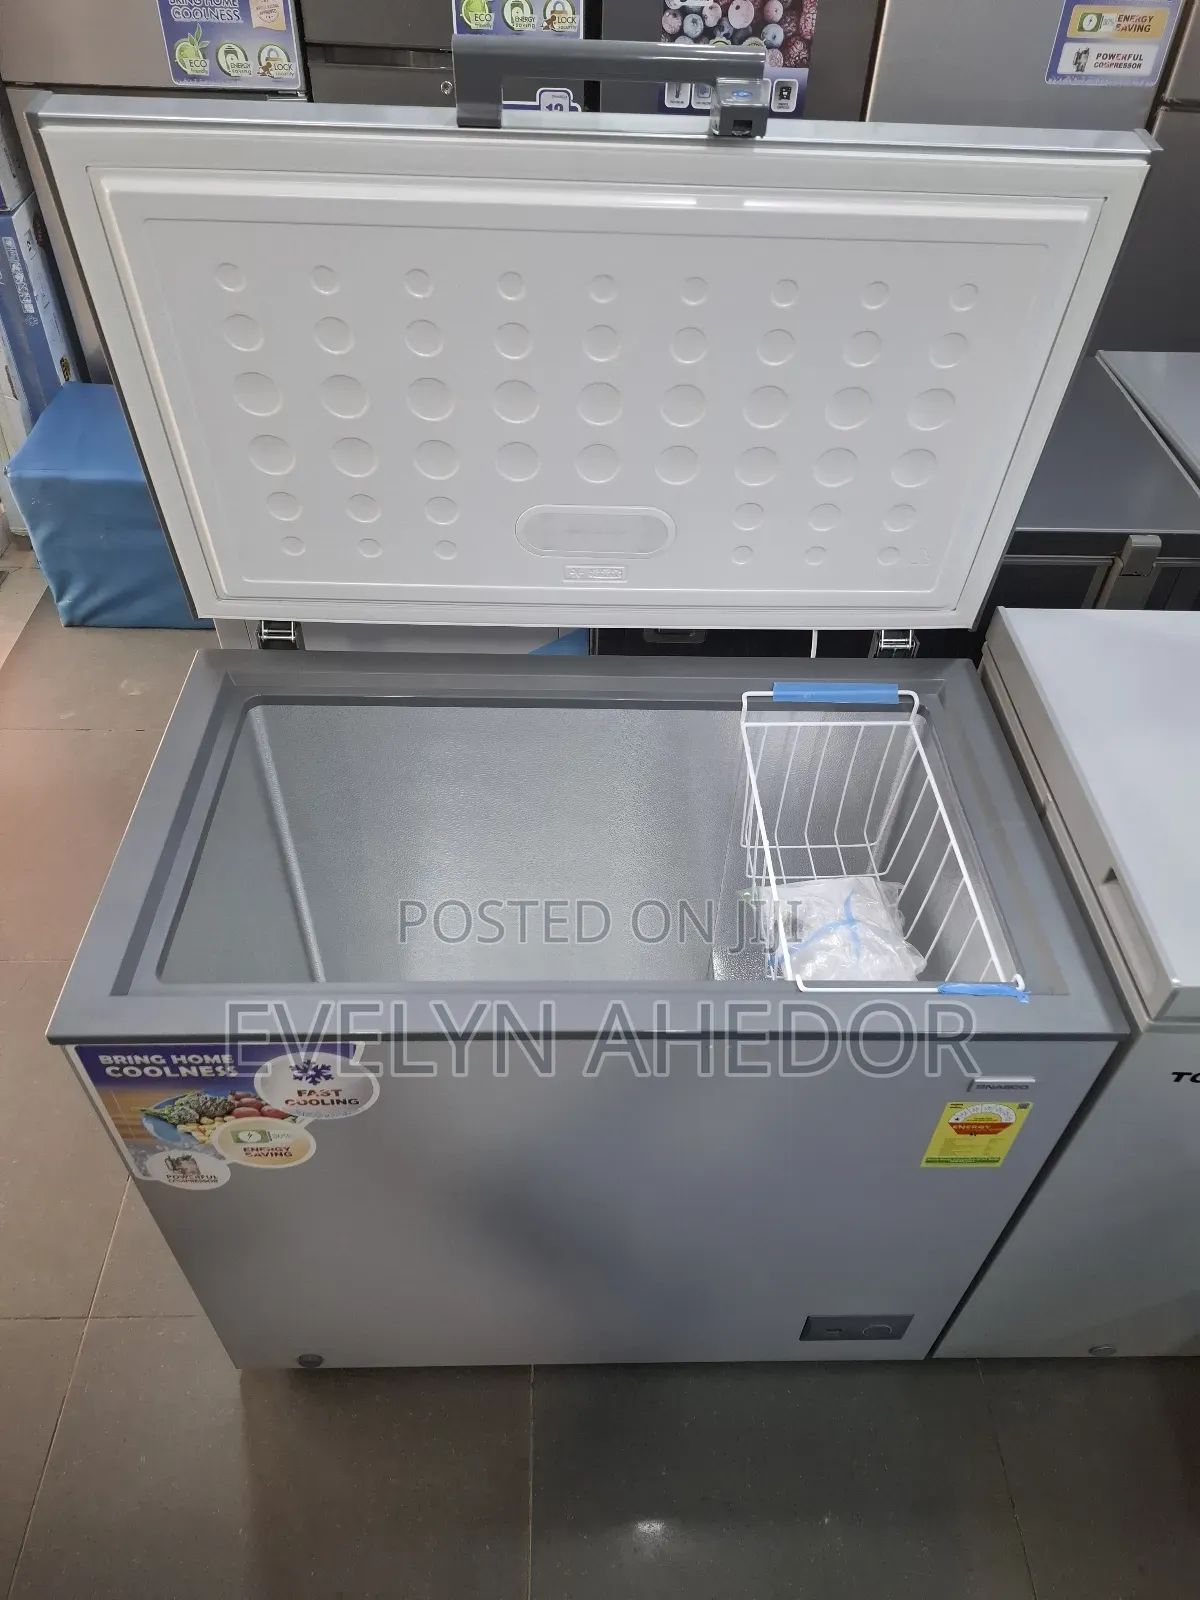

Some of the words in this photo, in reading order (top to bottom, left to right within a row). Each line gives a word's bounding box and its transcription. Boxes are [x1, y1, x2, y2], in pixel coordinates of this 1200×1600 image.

[171, 6, 243, 22] COOLNESS
[474, 13, 492, 22] ECO
[1117, 14, 1154, 23] ENERGY
[557, 16, 577, 24] LOCK
[1114, 24, 1151, 32] SAVING
[1096, 52, 1144, 61] POWERFUL
[274, 63, 293, 71] LOCK
[1093, 61, 1142, 69] COMPRESSOR
[98, 1054, 166, 1065] BRING
[170, 1054, 234, 1065] HOME
[104, 1065, 239, 1078] COOLNESS
[296, 1088, 343, 1097] FAST
[284, 1098, 360, 1106] COOLING
